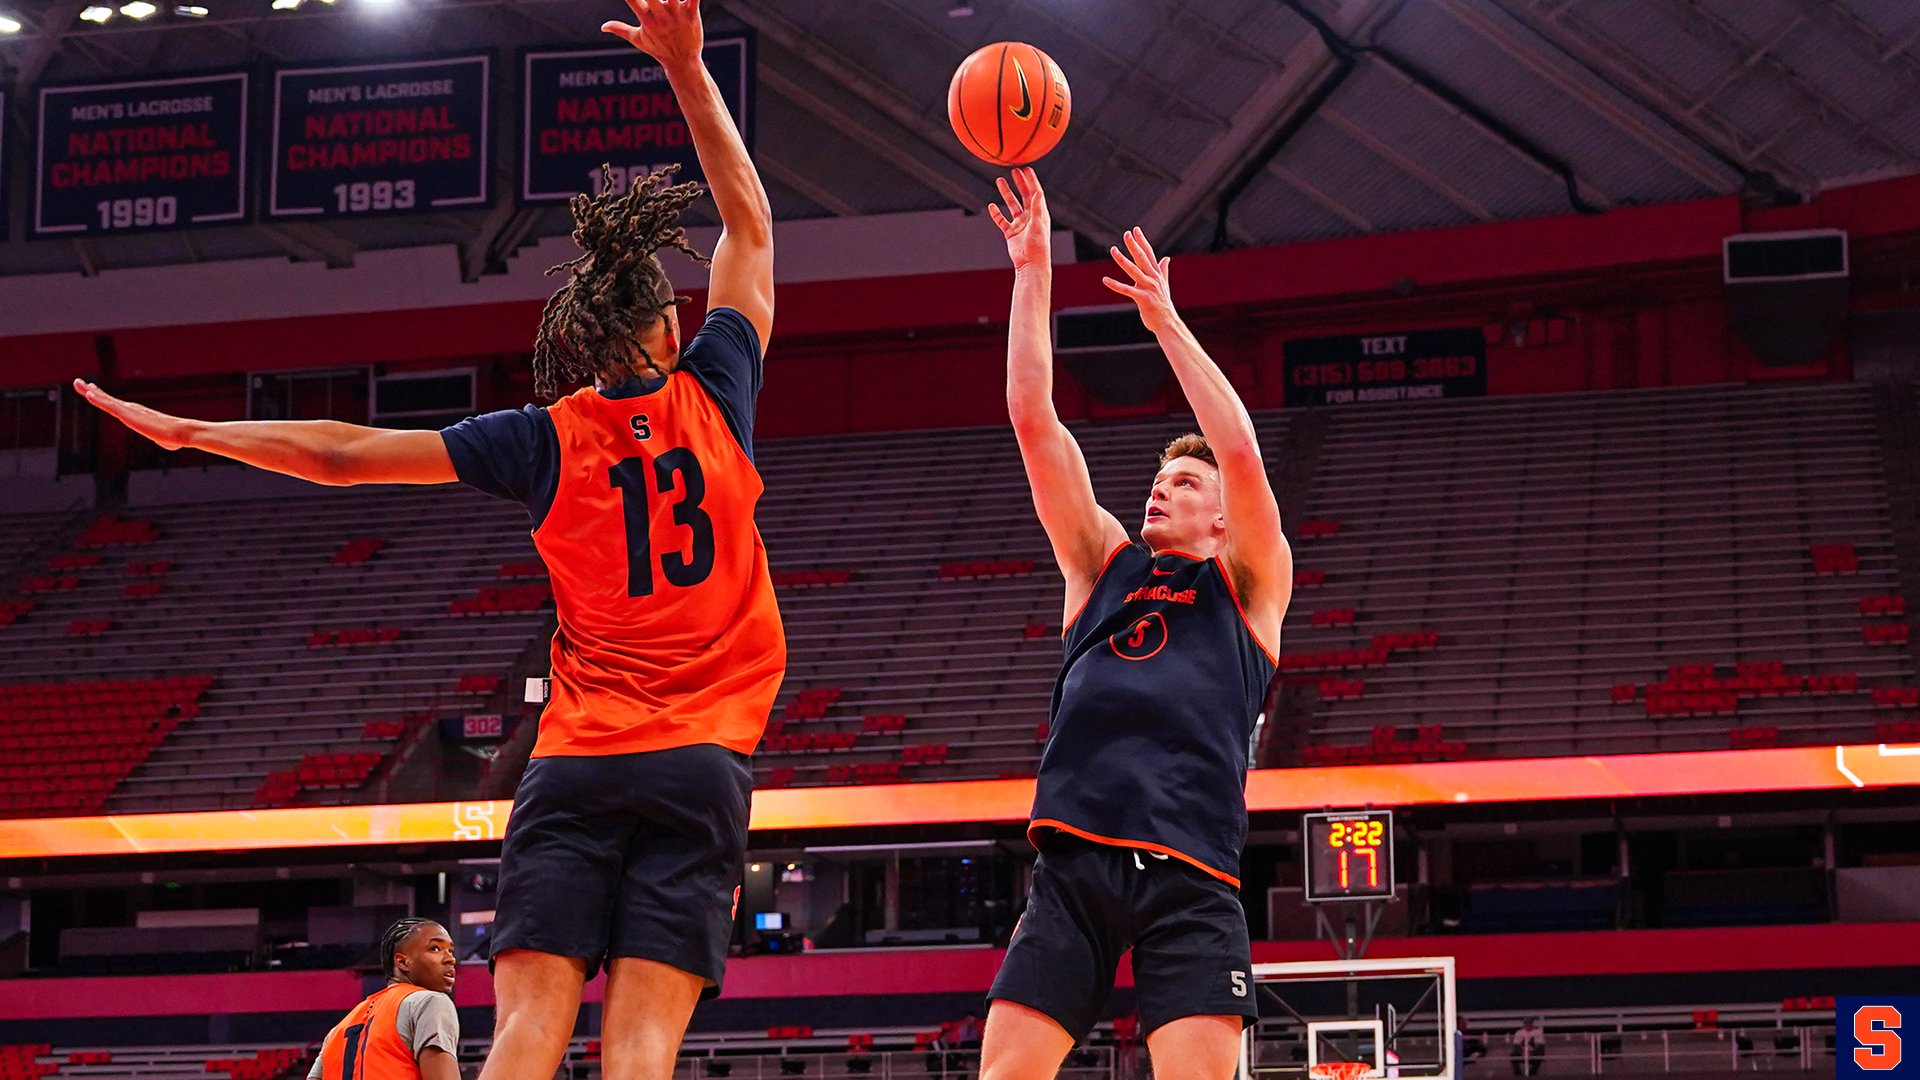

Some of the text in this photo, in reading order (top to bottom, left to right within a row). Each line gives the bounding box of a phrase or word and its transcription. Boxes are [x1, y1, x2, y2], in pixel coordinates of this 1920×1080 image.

[307, 79, 454, 104] MEN'S LACROSSE
[559, 66, 667, 88] MEN'S LACR
[71, 96, 214, 121] MEN'S LACROSSE
[304, 105, 457, 140] NATIONAL
[556, 92, 684, 124] NATION
[68, 122, 217, 156] NATIONAL
[286, 134, 473, 171] CHAMPIONS
[540, 121, 693, 155] CHAMPIO
[52, 151, 231, 188] CHAMPIONS
[333, 179, 416, 213] 1993
[97, 196, 178, 230] 1990
[1360, 335, 1407, 356] TEXT
[1326, 384, 1444, 404] FOR ASSISTANCE
[629, 413, 652, 441] S
[608, 446, 715, 598] 13
[465, 716, 501, 736] 302
[1328, 820, 1384, 848] 2:22
[1339, 847, 1377, 889] 17
[1230, 970, 1248, 998] 5
